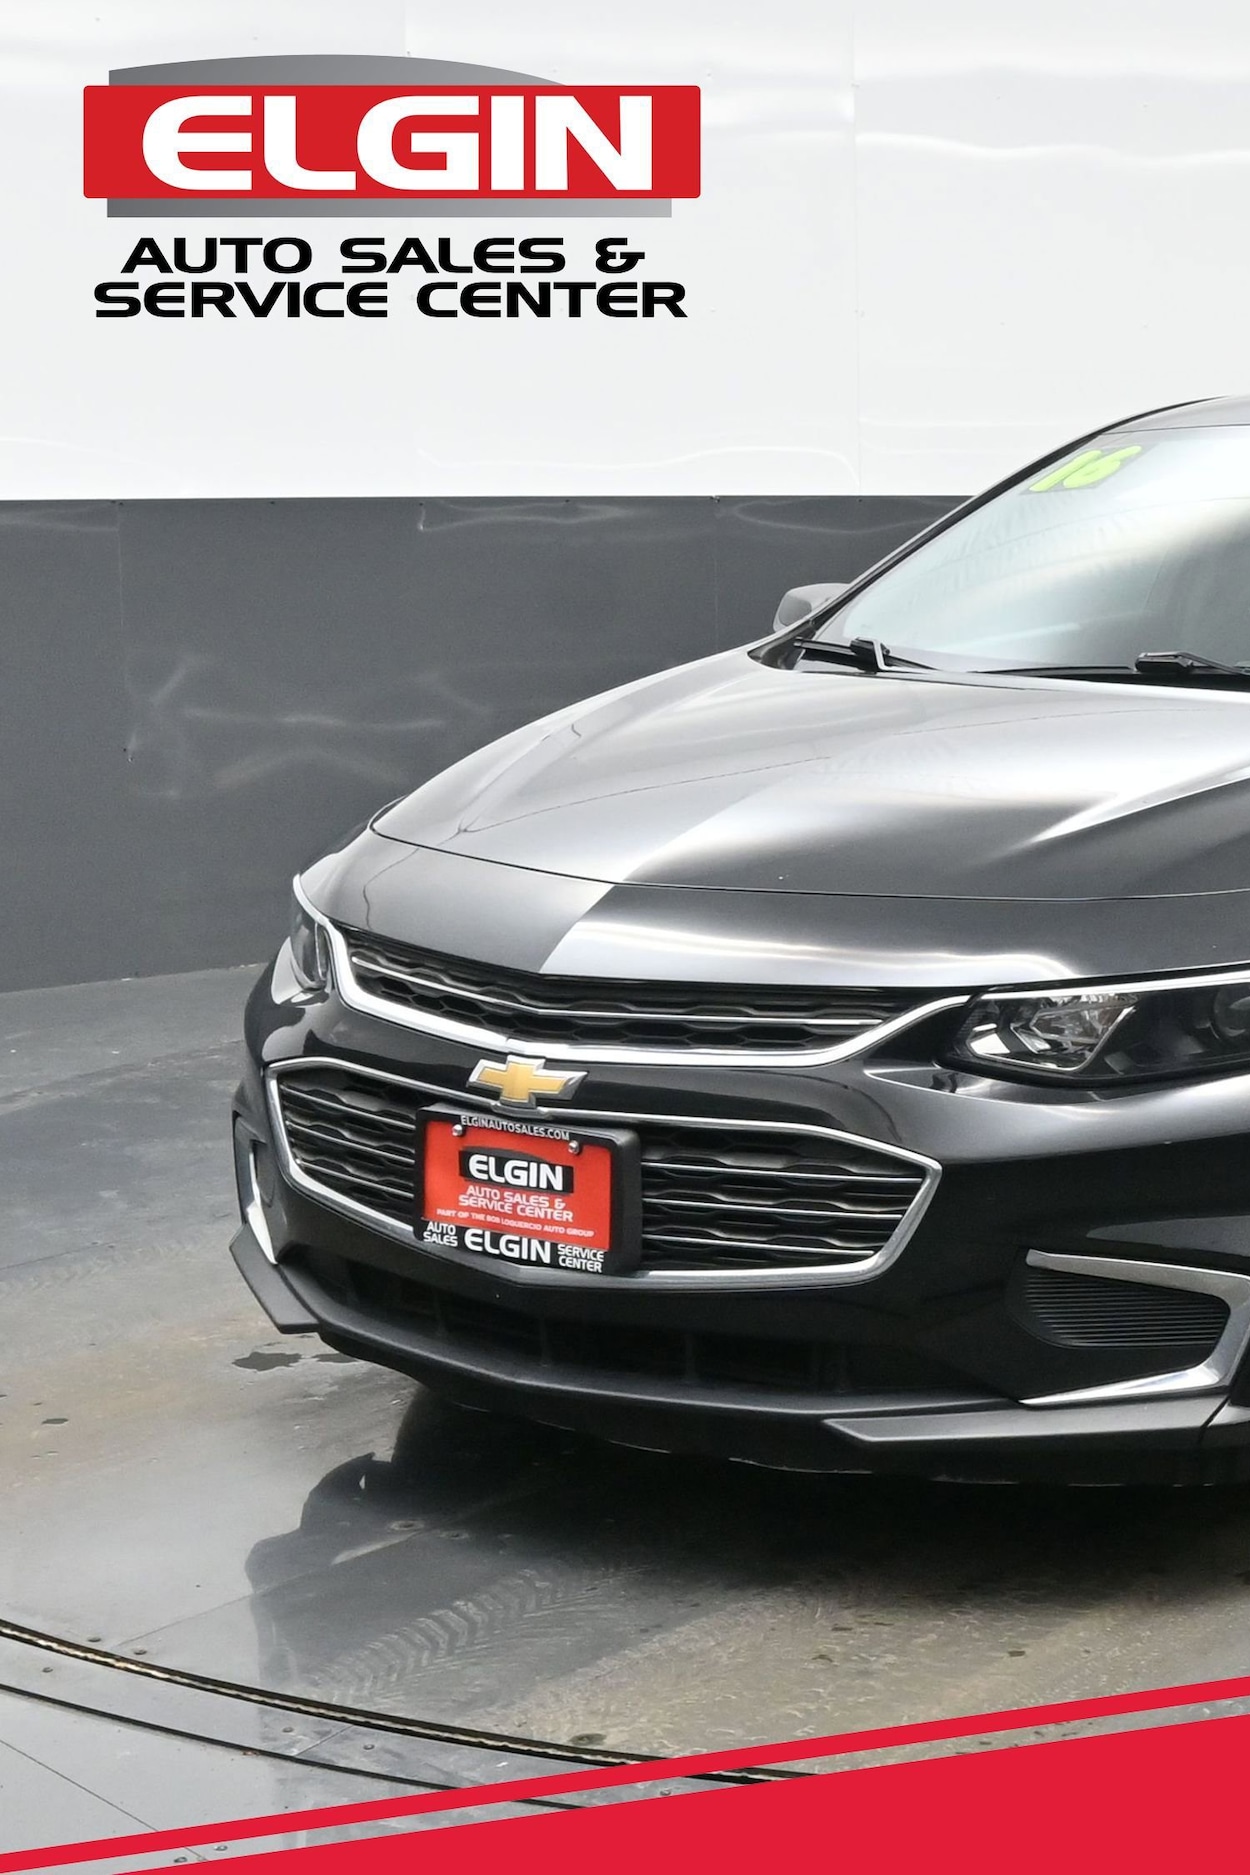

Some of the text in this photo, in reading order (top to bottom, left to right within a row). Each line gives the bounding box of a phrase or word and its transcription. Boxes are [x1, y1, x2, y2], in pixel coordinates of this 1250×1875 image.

[1029, 445, 1142, 492] 16
[460, 1115, 570, 1141] ELGINAUTOSALES.COM
[468, 1153, 563, 1191] ELGIN
[458, 1194, 573, 1222] SERVICE CENTER
[466, 1184, 566, 1209] AUTO SALES &
[427, 1221, 456, 1236] AUTO
[436, 1208, 457, 1218] PART
[457, 1211, 469, 1219] OF
[543, 1224, 565, 1234] AUTO
[566, 1227, 595, 1237] GROUP
[423, 1231, 458, 1247] SALES
[464, 1228, 551, 1264] ELGIN
[557, 1244, 605, 1262] SERVICE
[558, 1256, 602, 1273] CENTER
